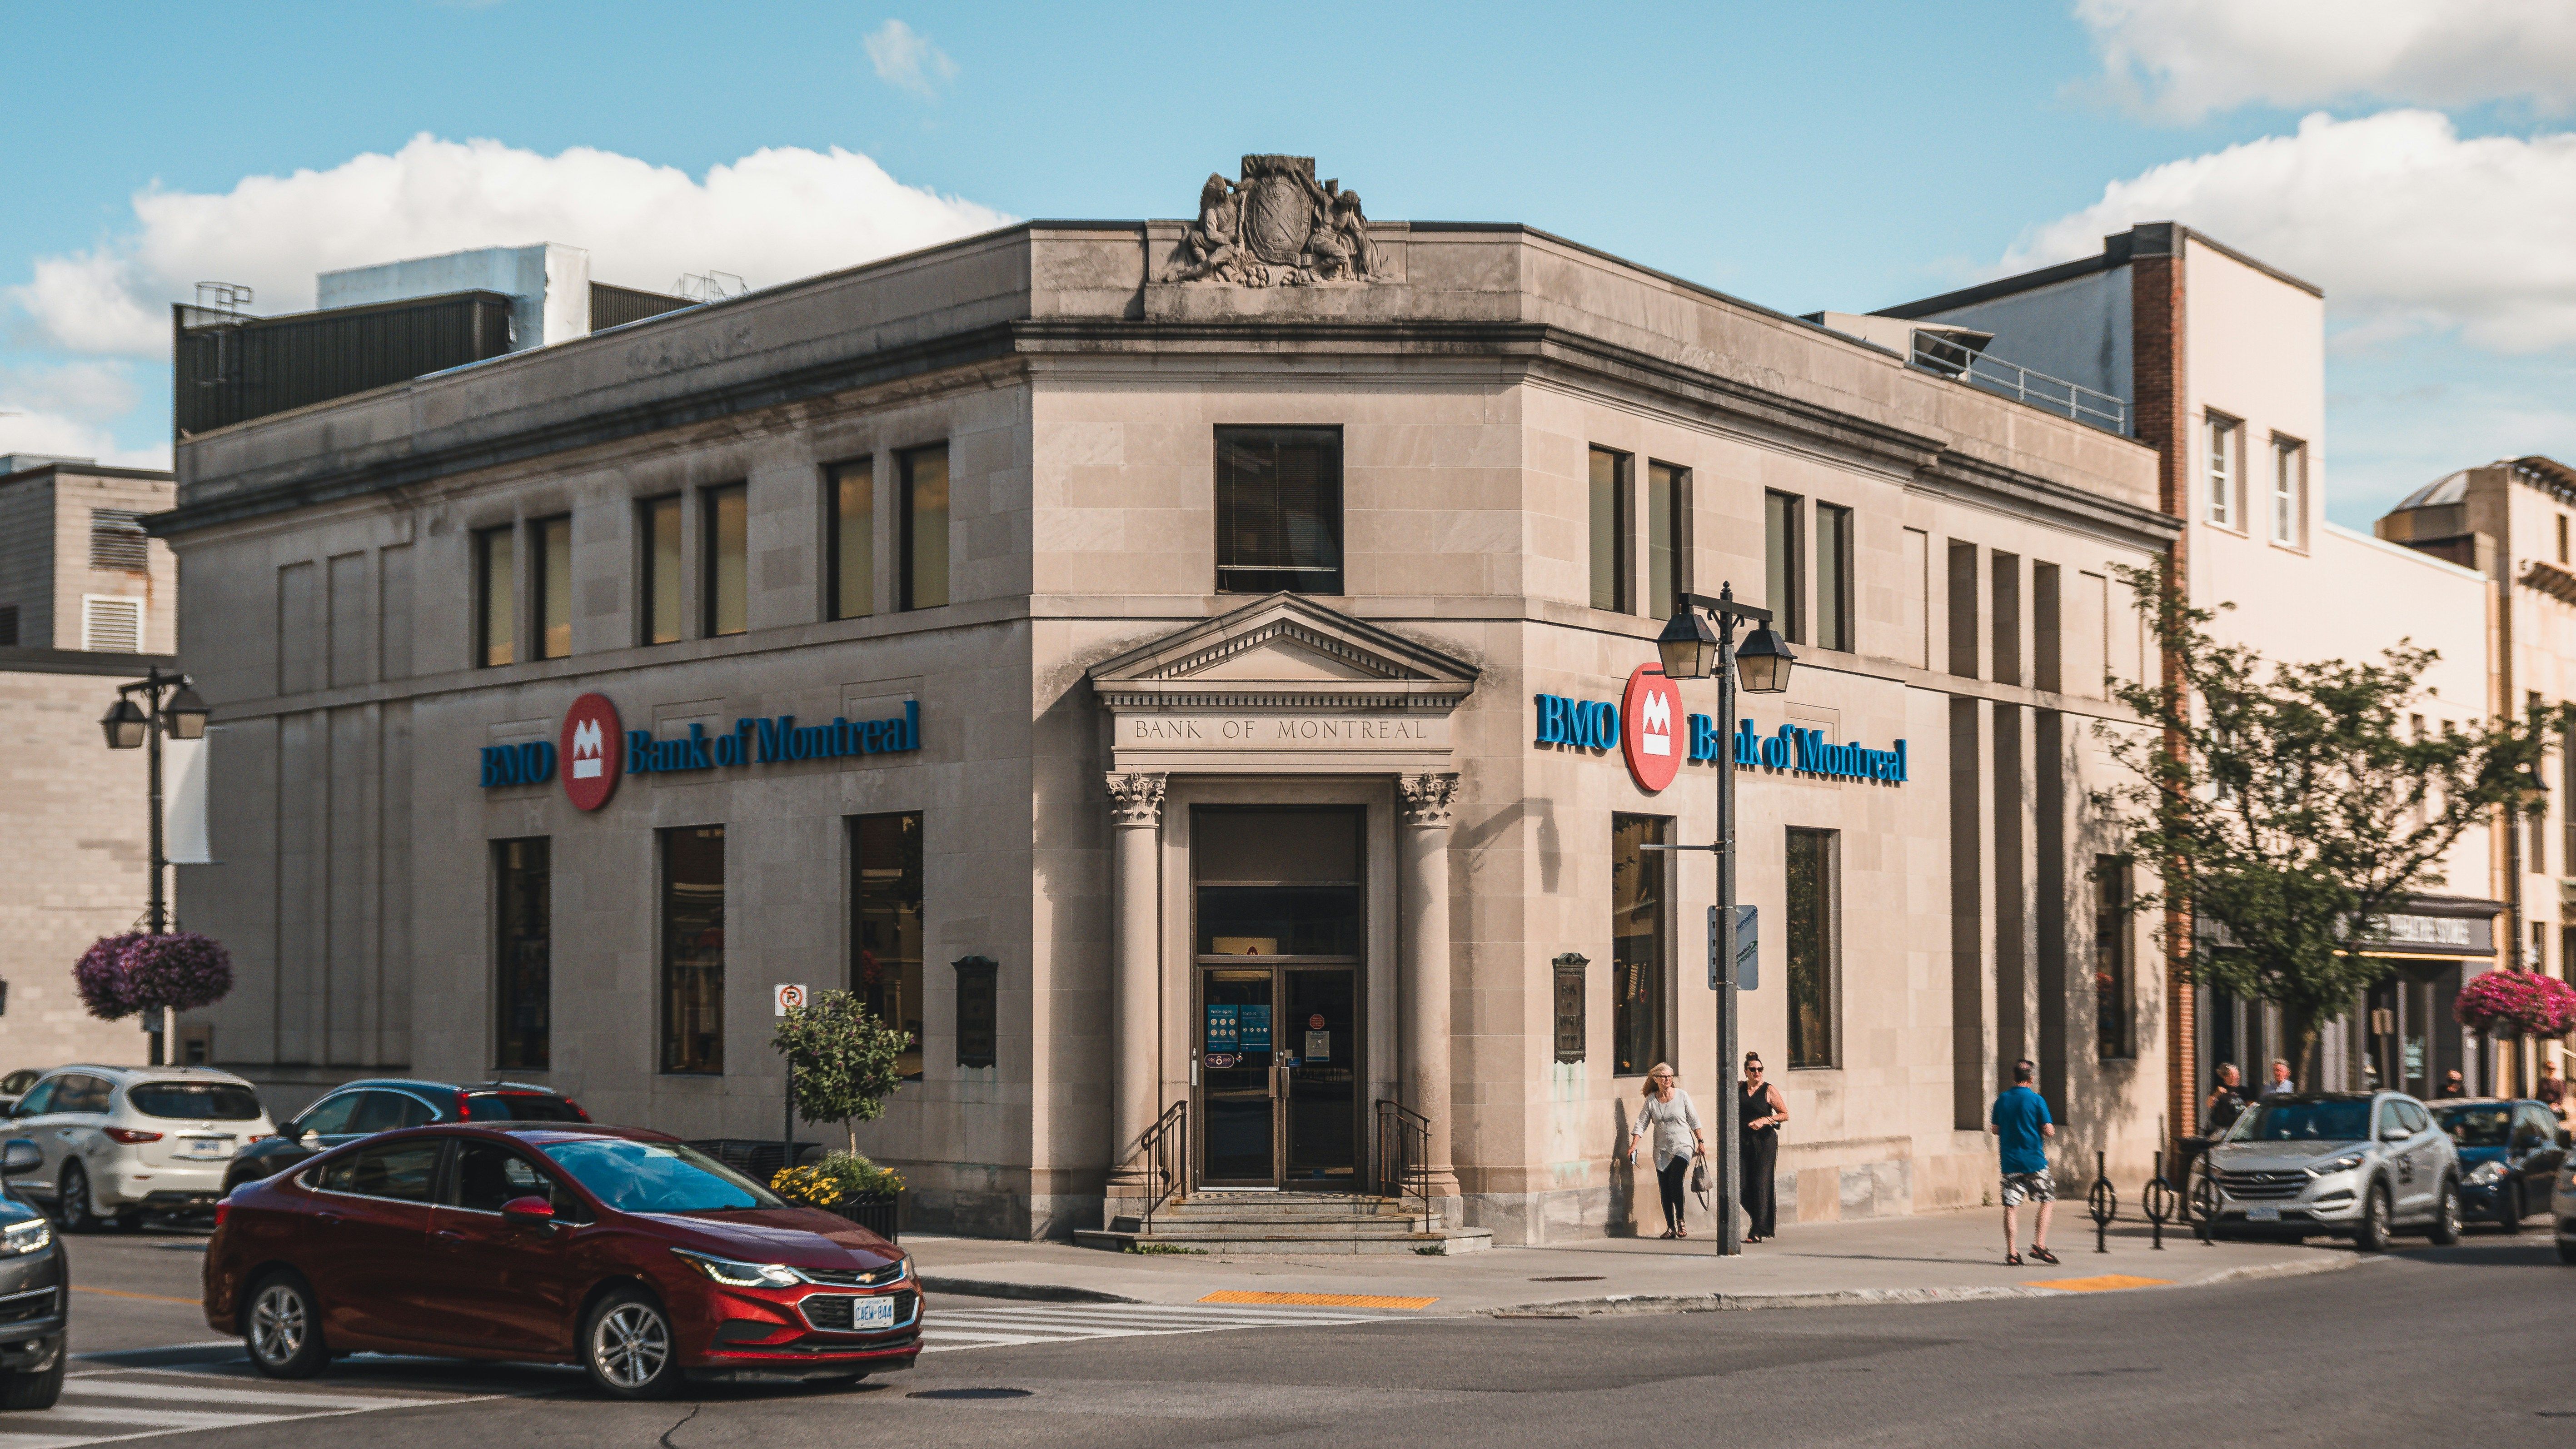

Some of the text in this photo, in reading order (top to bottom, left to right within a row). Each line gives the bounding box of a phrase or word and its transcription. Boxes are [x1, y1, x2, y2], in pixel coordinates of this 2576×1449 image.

[480, 700, 921, 787] BMO Bank of Montreal
[1135, 720, 1427, 738] BANK OF MONTREAL
[1536, 694, 1908, 781] BMO Bnk of Montreal
